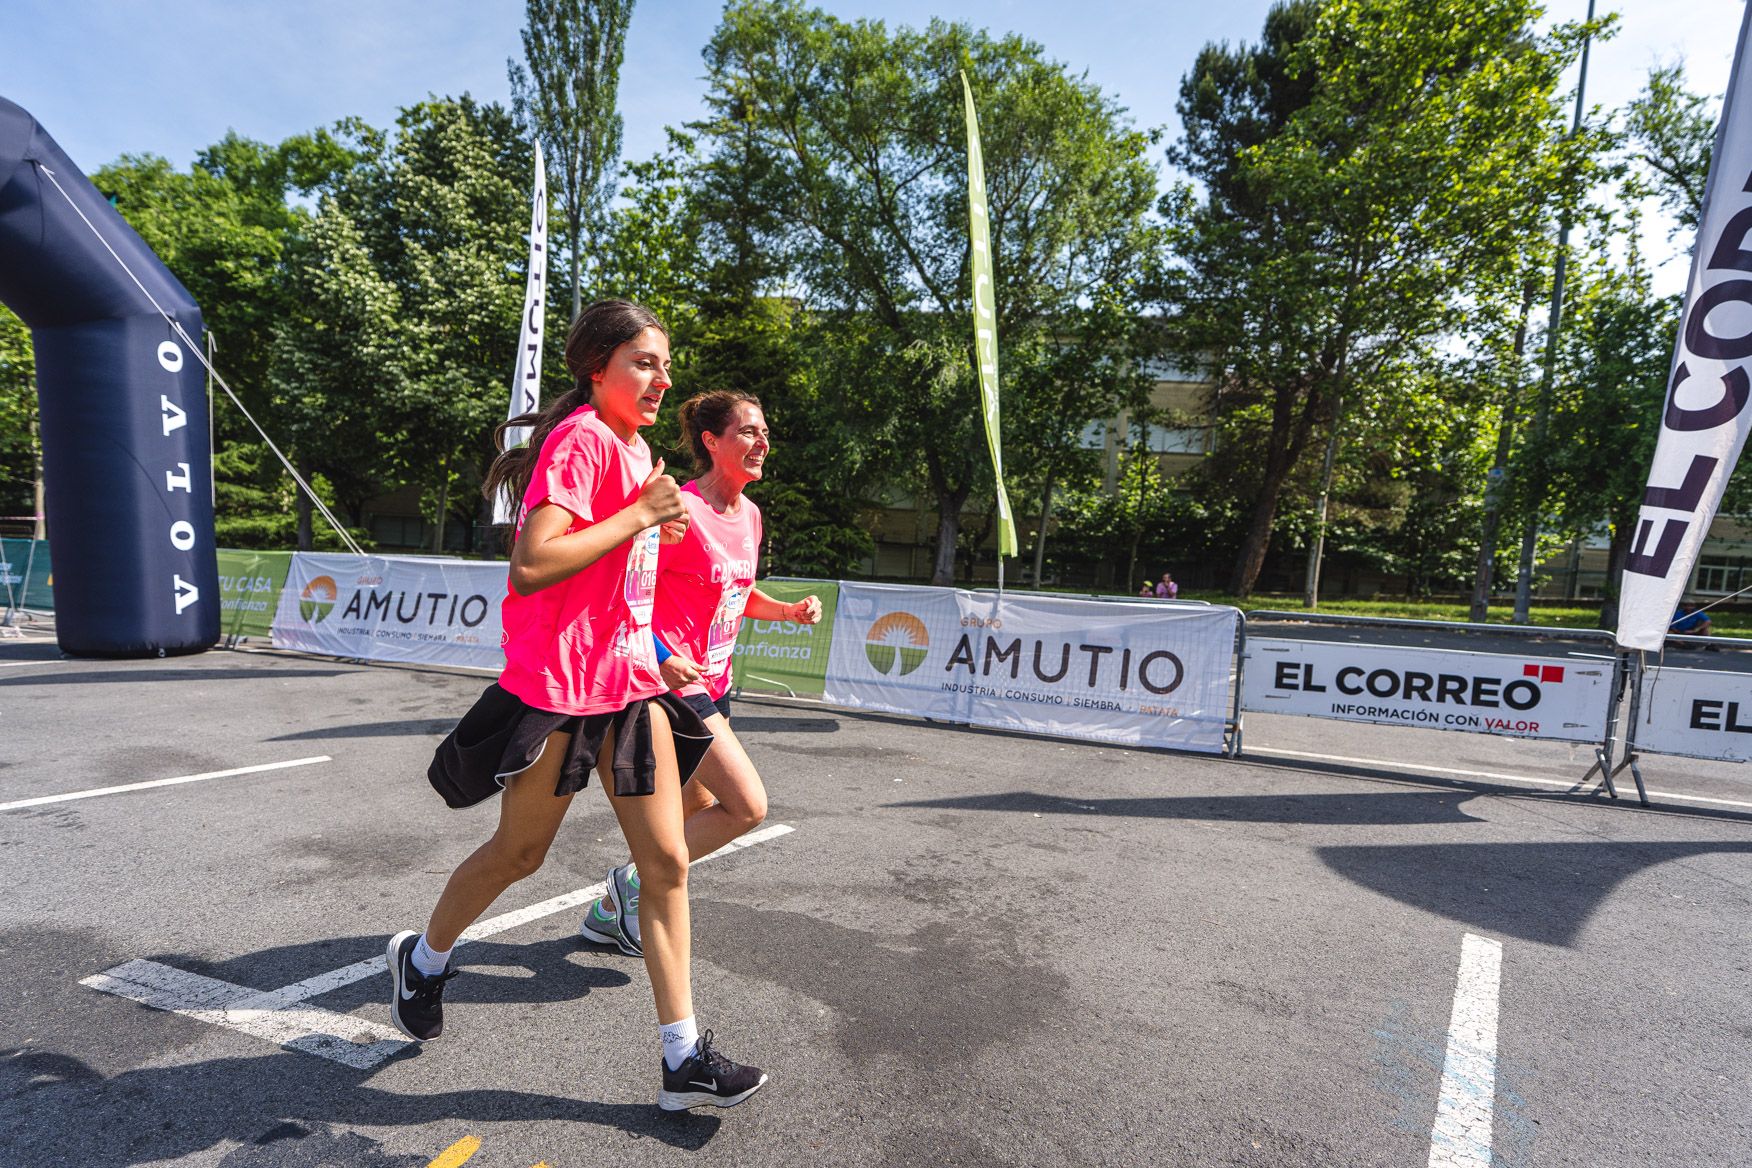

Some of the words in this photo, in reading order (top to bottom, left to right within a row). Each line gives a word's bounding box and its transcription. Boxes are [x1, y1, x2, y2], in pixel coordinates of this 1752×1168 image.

[525, 188, 543, 414] AMUTIO
[1665, 170, 1752, 432] CO
[157, 340, 200, 615] VOLVO
[1624, 455, 1719, 579] EL
[236, 576, 272, 593] CASA
[220, 598, 267, 611] onfianza
[342, 589, 488, 627] AMUTIO
[337, 627, 370, 636] INDUSTRIA
[376, 630, 412, 640] CONSUMO
[753, 620, 813, 636] CASA
[960, 616, 1003, 629] GRUPO
[733, 641, 811, 659] onfianza
[944, 633, 1184, 695] AMUTIO
[941, 682, 996, 697] INDUSTRIA
[1005, 689, 1063, 705] CONSUMO
[1073, 697, 1122, 712] SIEMBRA
[1274, 661, 1327, 693] EL
[1335, 665, 1542, 710] CORREO
[1331, 703, 1439, 727] INFORMACIÓN
[1444, 713, 1480, 727] CON
[1484, 717, 1540, 733] VALOR
[1689, 698, 1752, 734] EL
